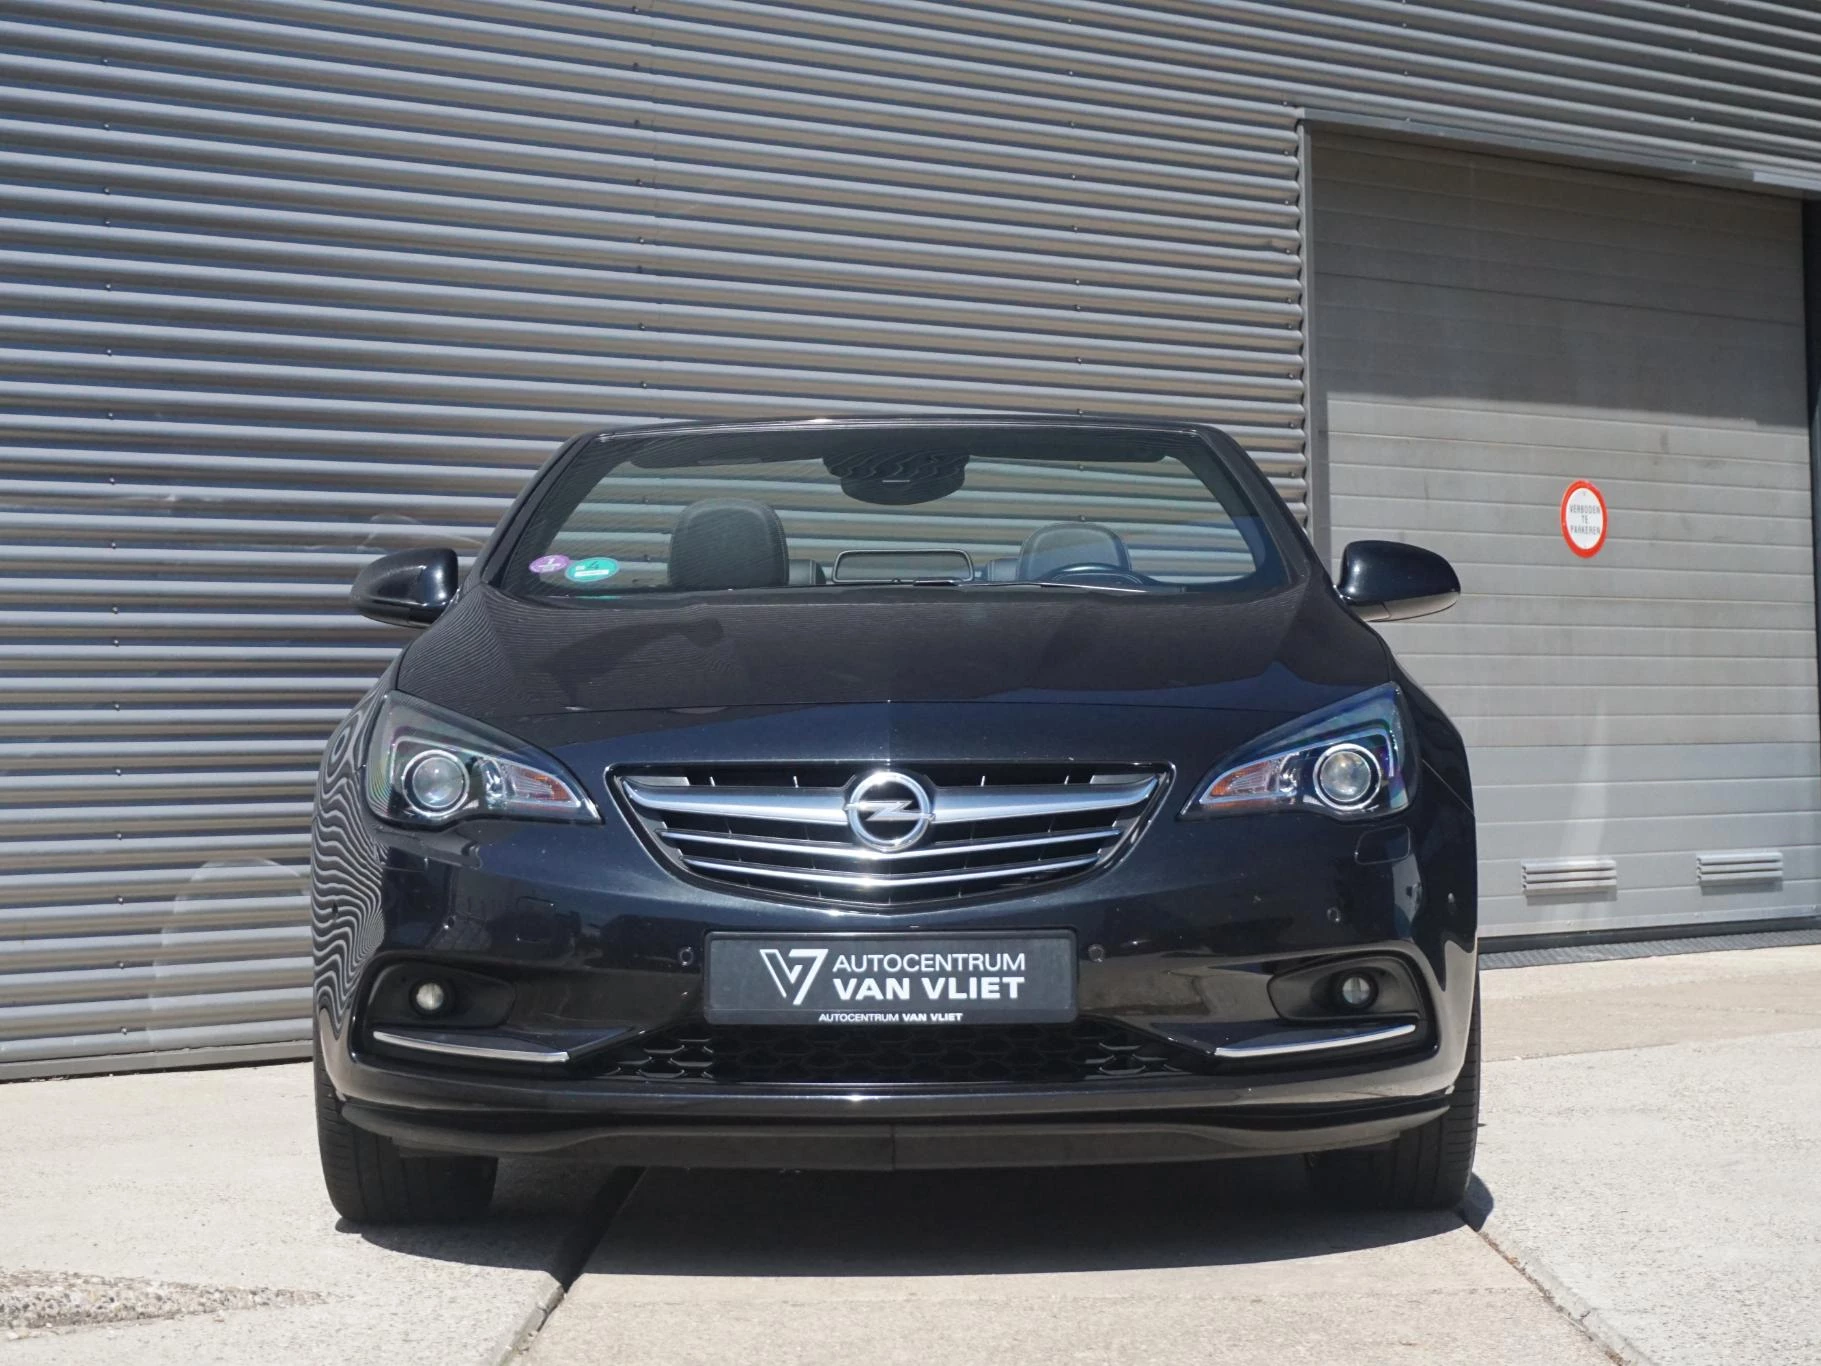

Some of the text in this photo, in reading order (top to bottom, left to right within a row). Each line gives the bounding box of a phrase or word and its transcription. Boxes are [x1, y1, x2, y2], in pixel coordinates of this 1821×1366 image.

[1570, 504, 1600, 514] VERBODEN
[1581, 515, 1589, 524] TE
[1570, 525, 1600, 535] PARKEREN
[832, 952, 1026, 972] AUTOCENTRUM
[833, 976, 1026, 1000] VAN VLIET
[818, 1012, 963, 1022] AUTOCENTRUM VAN VLIET
